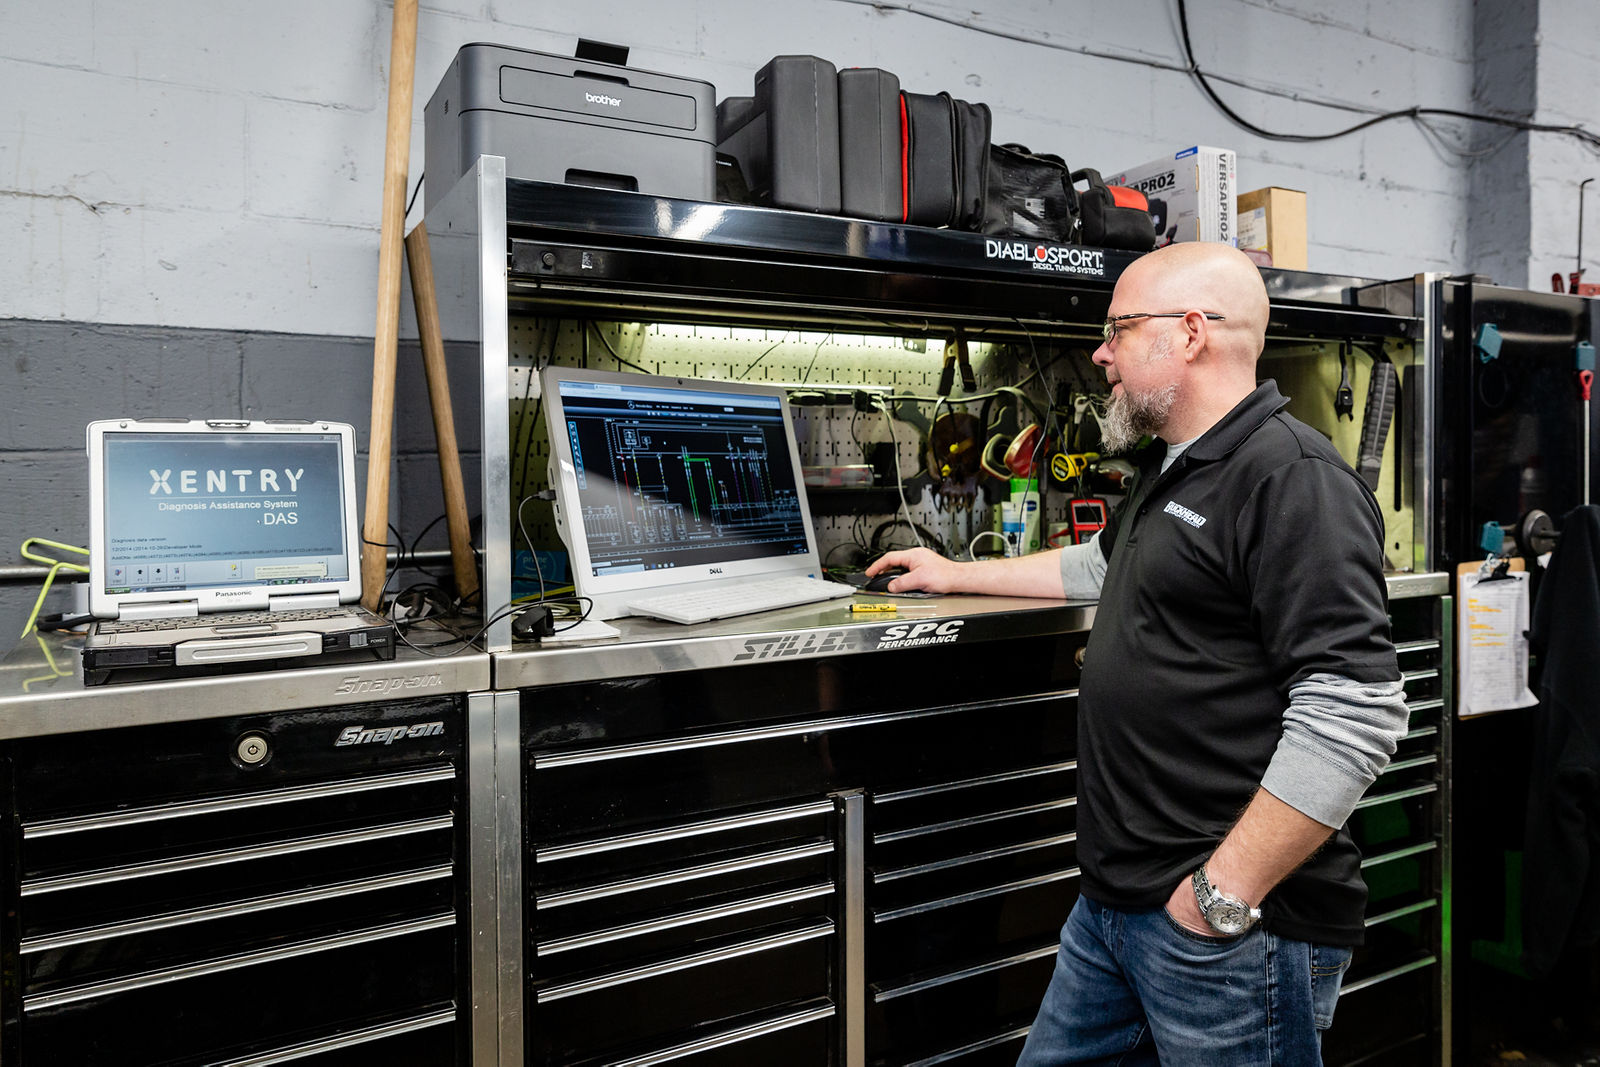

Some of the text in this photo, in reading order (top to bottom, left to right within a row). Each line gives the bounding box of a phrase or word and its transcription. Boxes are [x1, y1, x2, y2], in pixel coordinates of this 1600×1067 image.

[585, 92, 622, 107] brother
[1219, 153, 1228, 242] VERSAPRO2
[150, 468, 304, 495] XENTRY
[158, 500, 298, 512] Diagnosis Assistance System
[264, 512, 298, 525] DAS
[709, 567, 723, 575] DELL
[215, 590, 252, 598] Panasonic
[880, 620, 965, 641] SPC
[876, 634, 959, 650] PERFORMANCE
[334, 673, 443, 696] Snap-on
[334, 721, 444, 747] Snap-on
